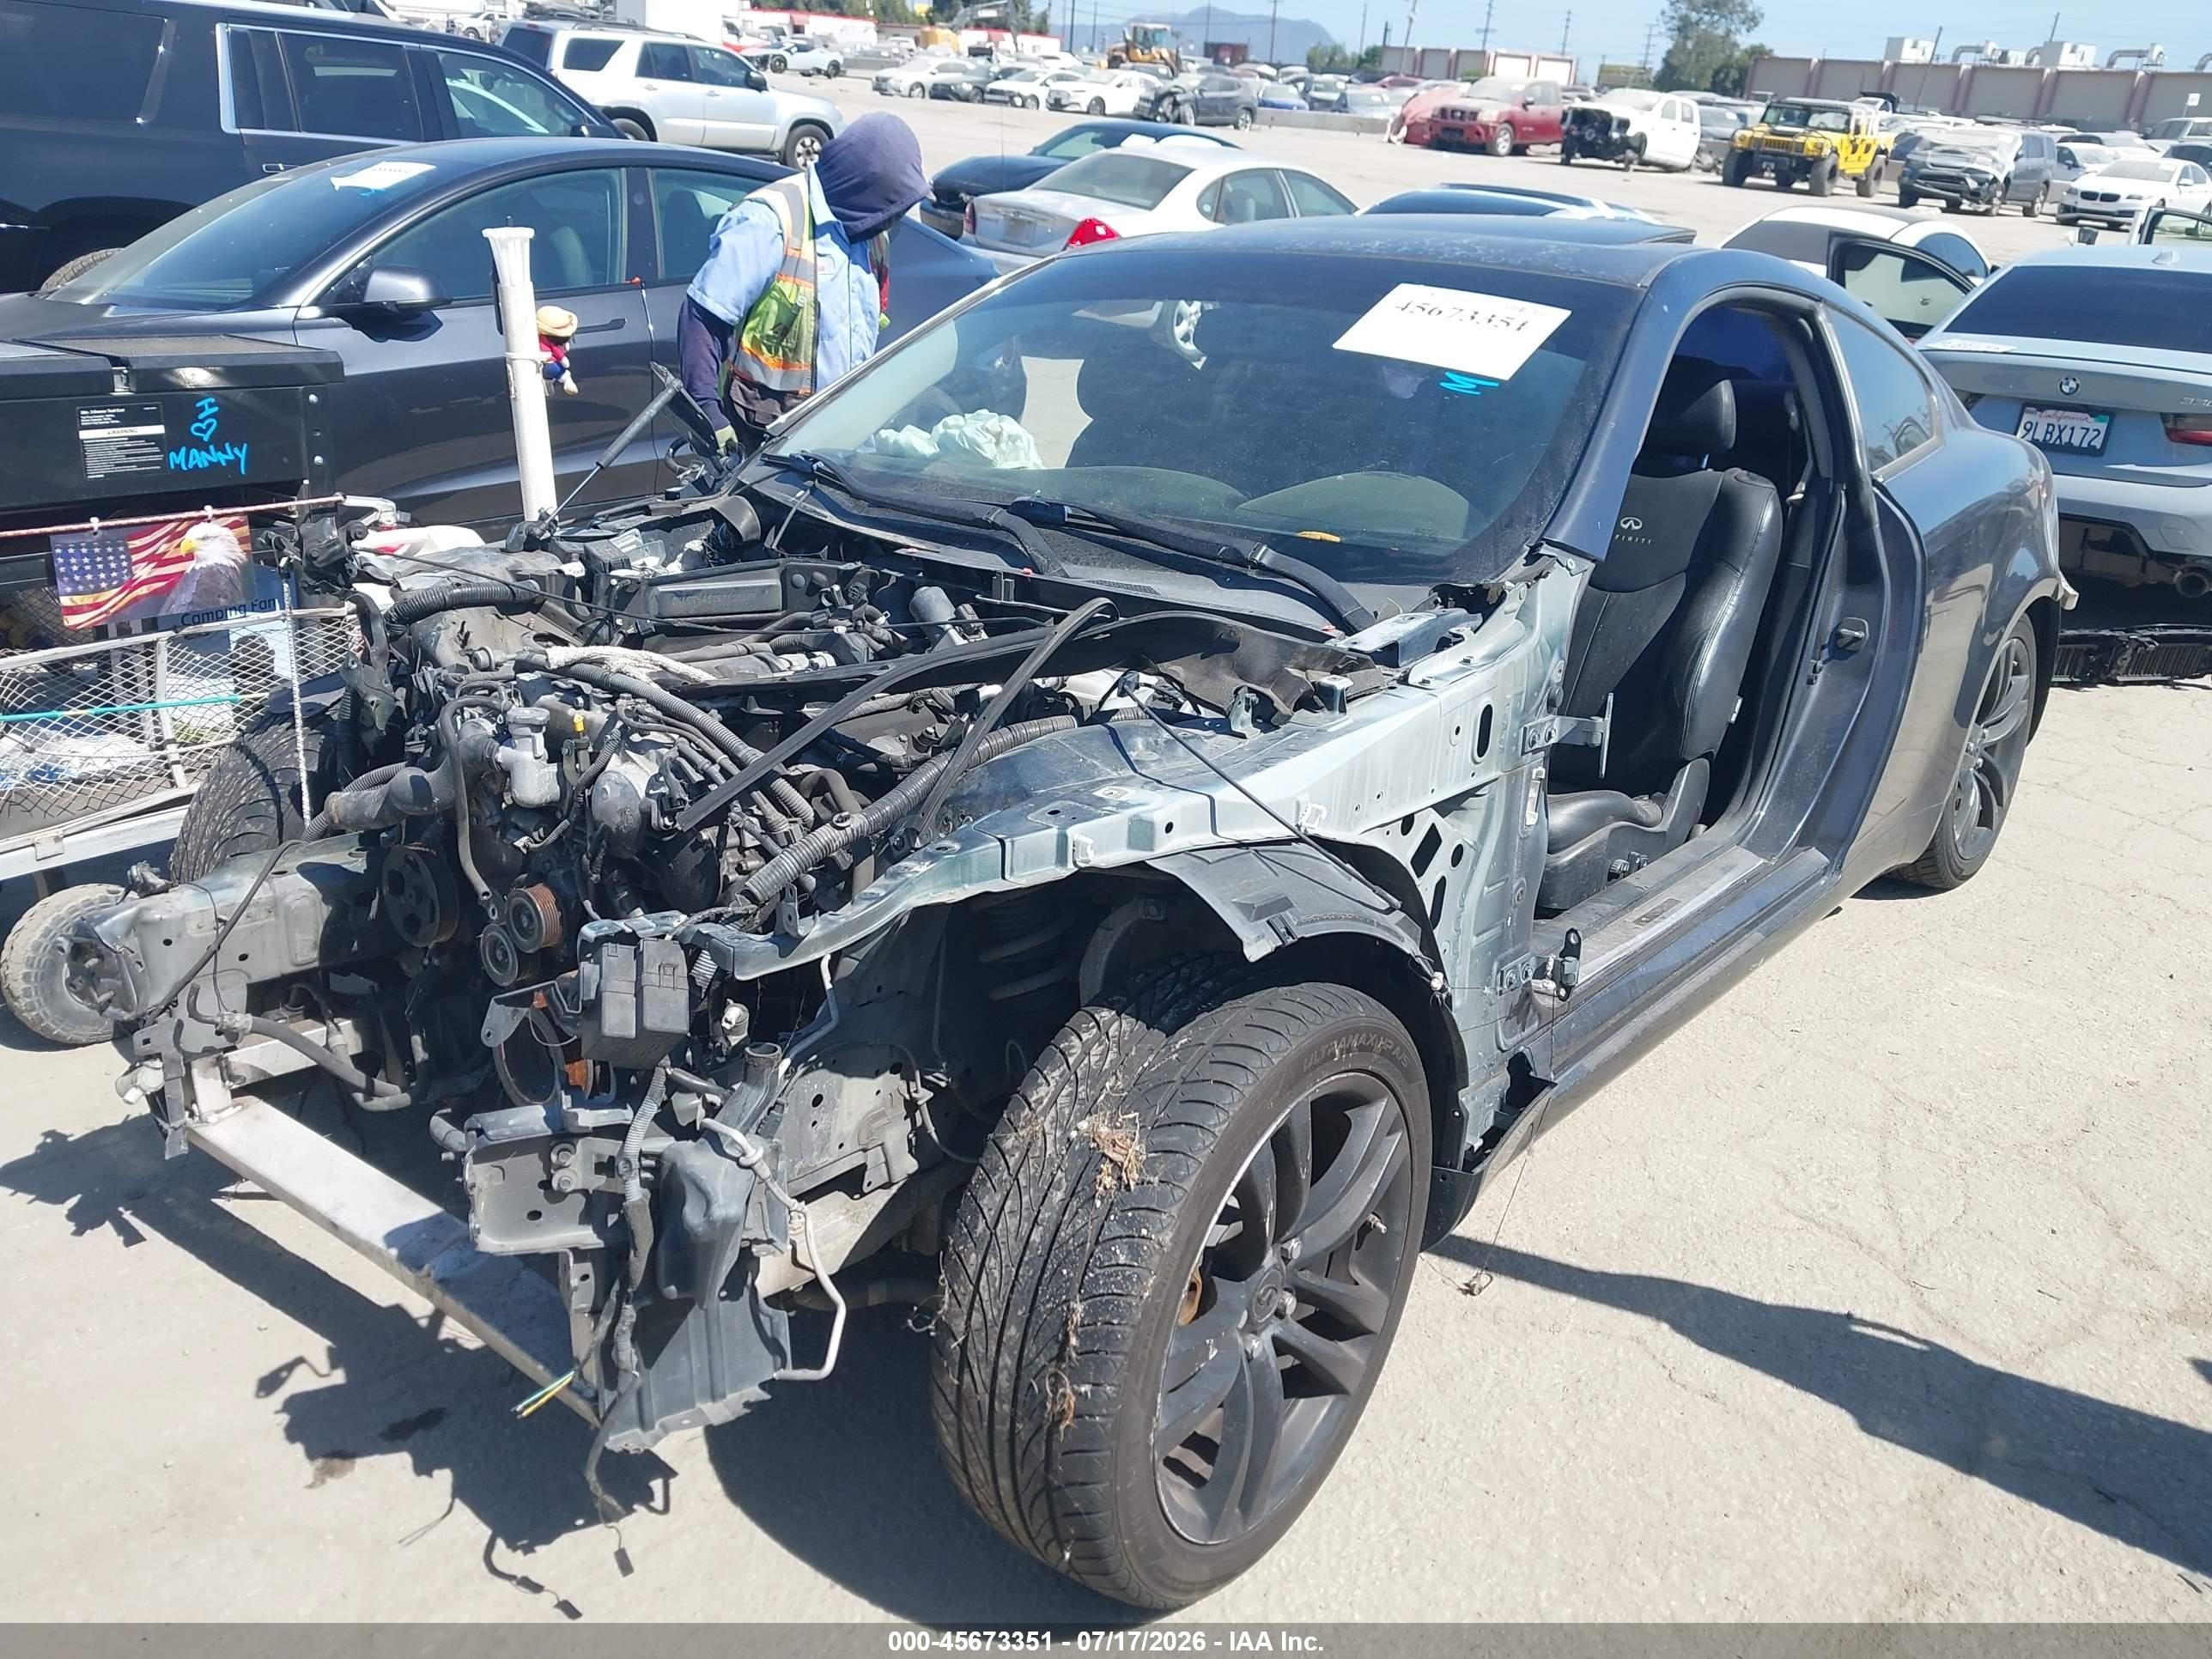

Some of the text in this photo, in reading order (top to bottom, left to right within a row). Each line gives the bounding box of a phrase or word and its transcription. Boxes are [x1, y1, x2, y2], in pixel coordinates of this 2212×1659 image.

[194, 397, 219, 420] I
[2039, 408, 2093, 423] California
[2021, 421, 2101, 447] 9LBX172
[168, 443, 248, 475] MANNY
[181, 599, 276, 626] Camping Fan
